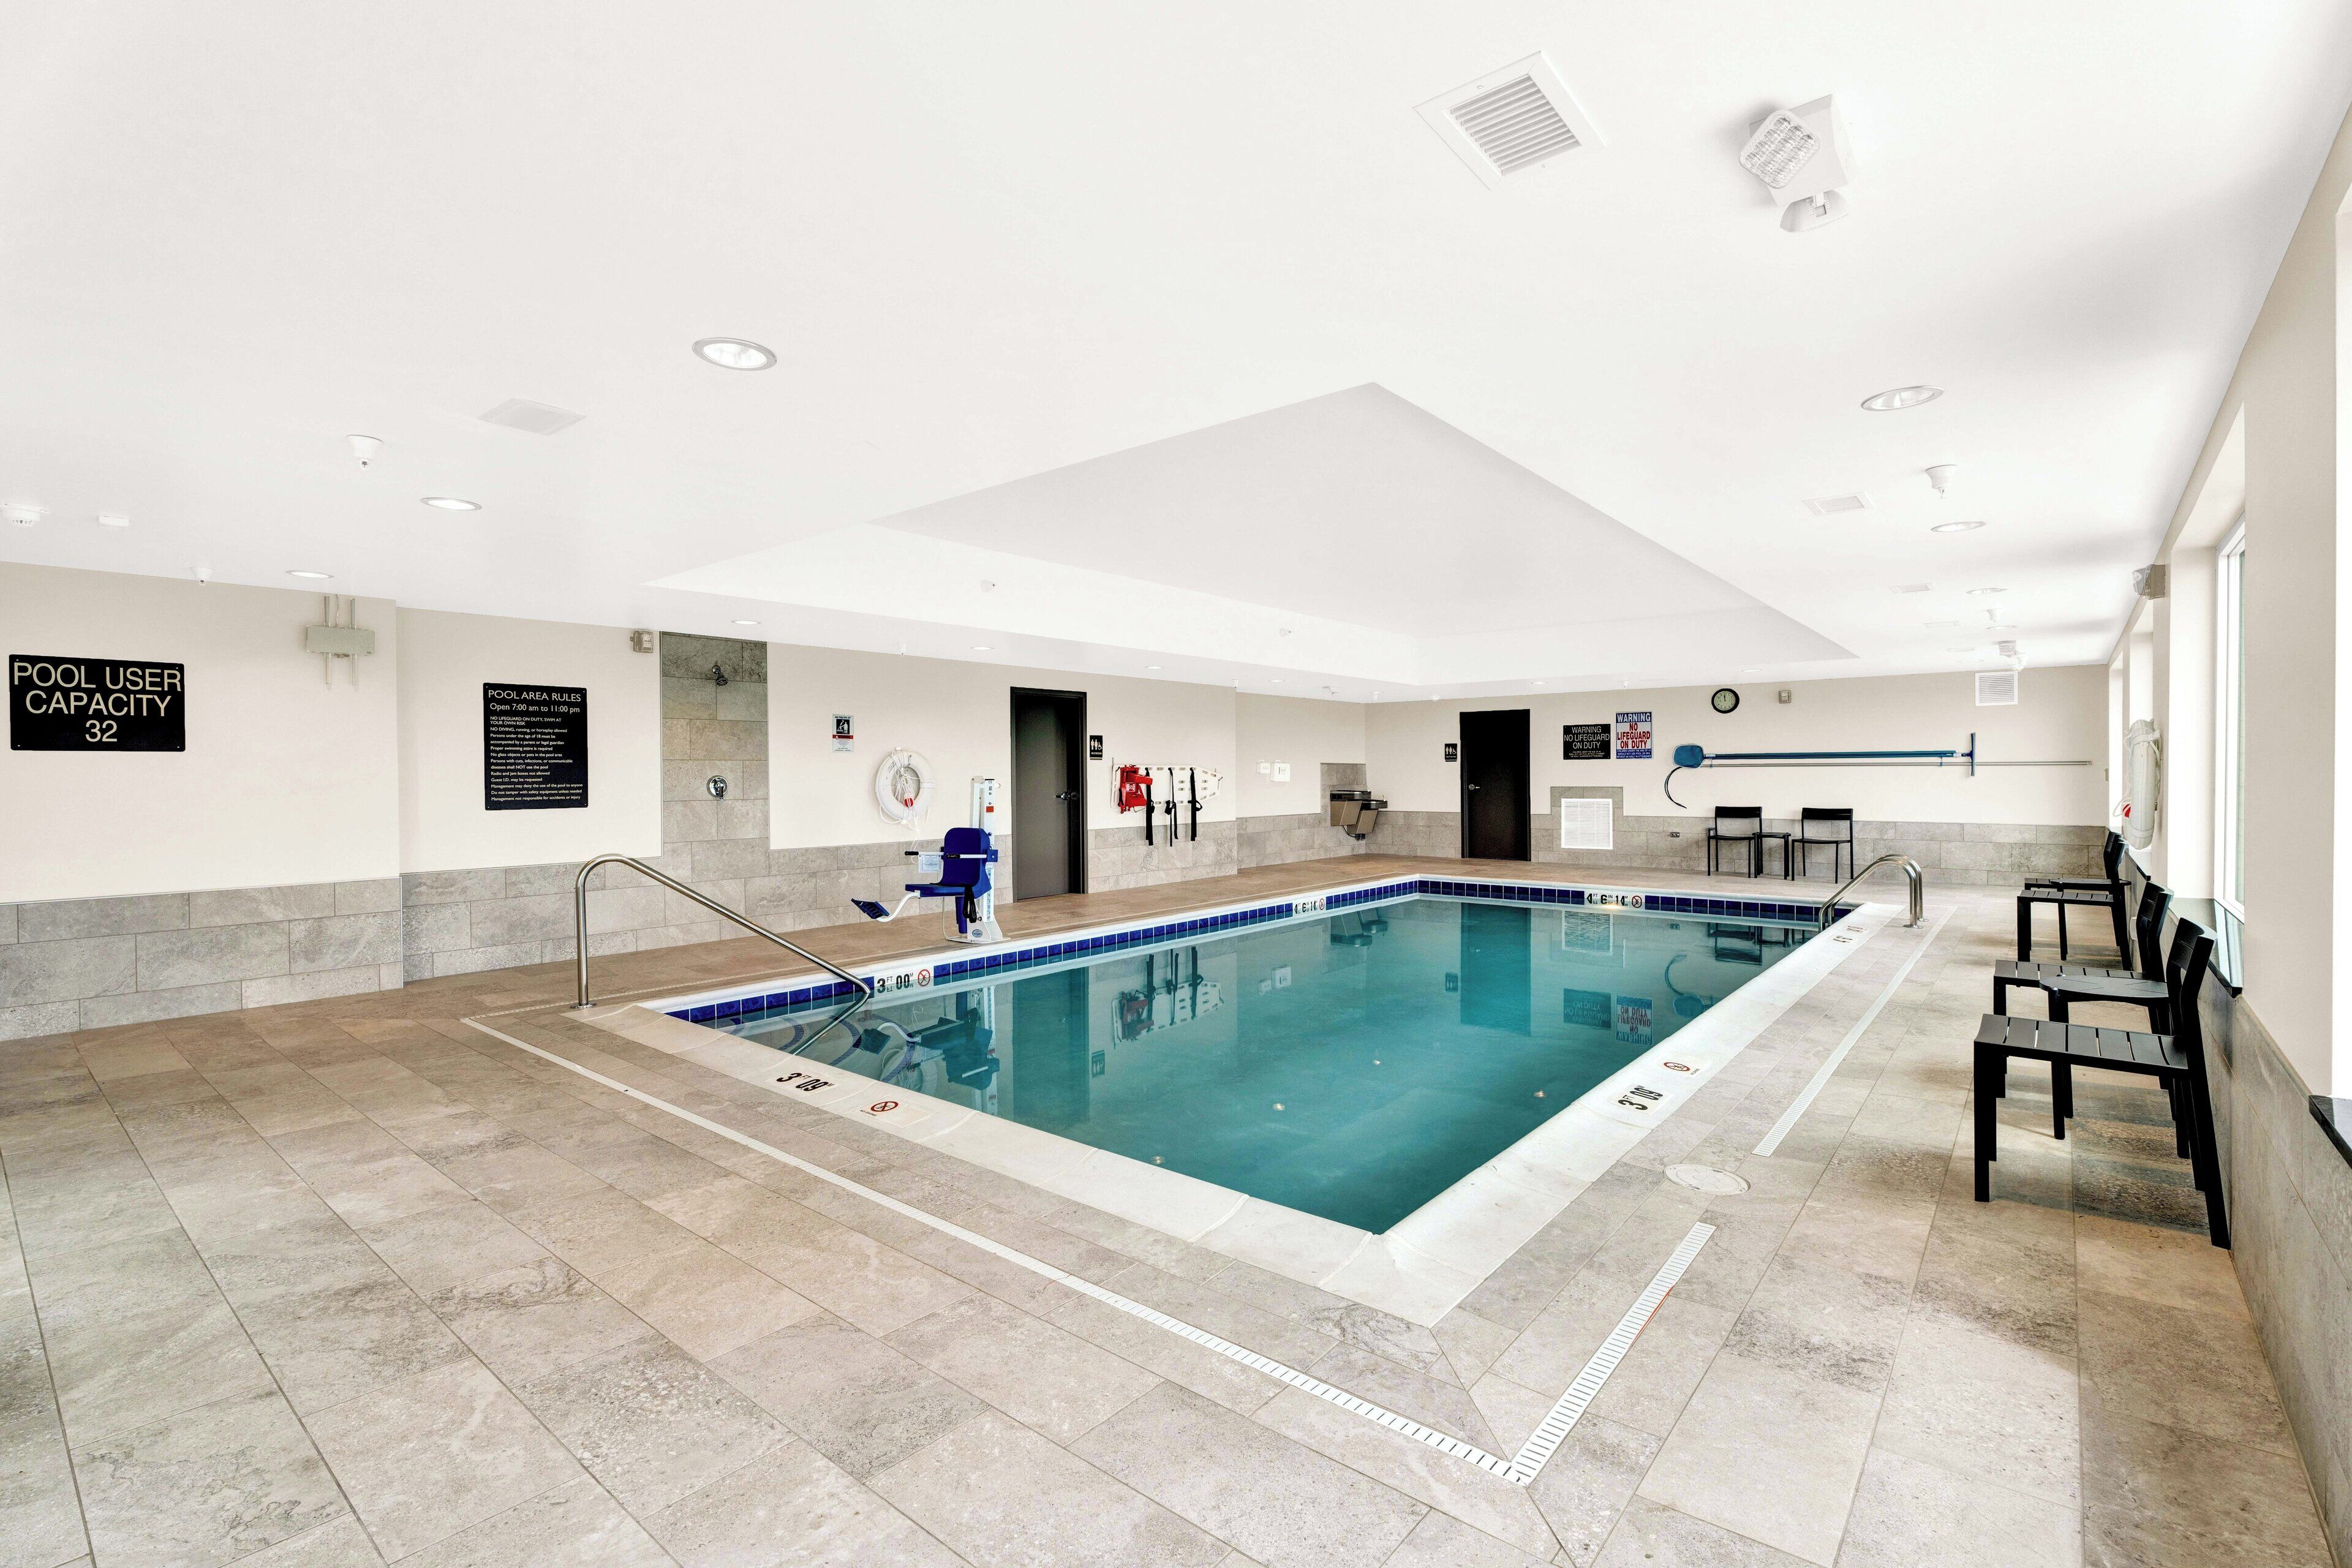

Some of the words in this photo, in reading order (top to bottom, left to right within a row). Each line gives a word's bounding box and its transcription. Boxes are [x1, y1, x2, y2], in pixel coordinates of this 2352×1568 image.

[14, 662, 96, 688] POOL
[106, 667, 181, 691] USER
[489, 690, 519, 699] POOL
[521, 692, 549, 700] AREA
[552, 693, 581, 701] RULES
[26, 690, 171, 716] CAPACITY
[490, 703, 510, 711] Open
[1617, 713, 1650, 723] WARNING
[85, 720, 117, 742] 32
[1630, 723, 1638, 731] NO
[1617, 731, 1650, 740] LIFEGUARD
[1620, 740, 1628, 749] ON
[1632, 740, 1647, 748] DUTY
[776, 1073, 802, 1082] 3
[1618, 1100, 1648, 1110] 3
